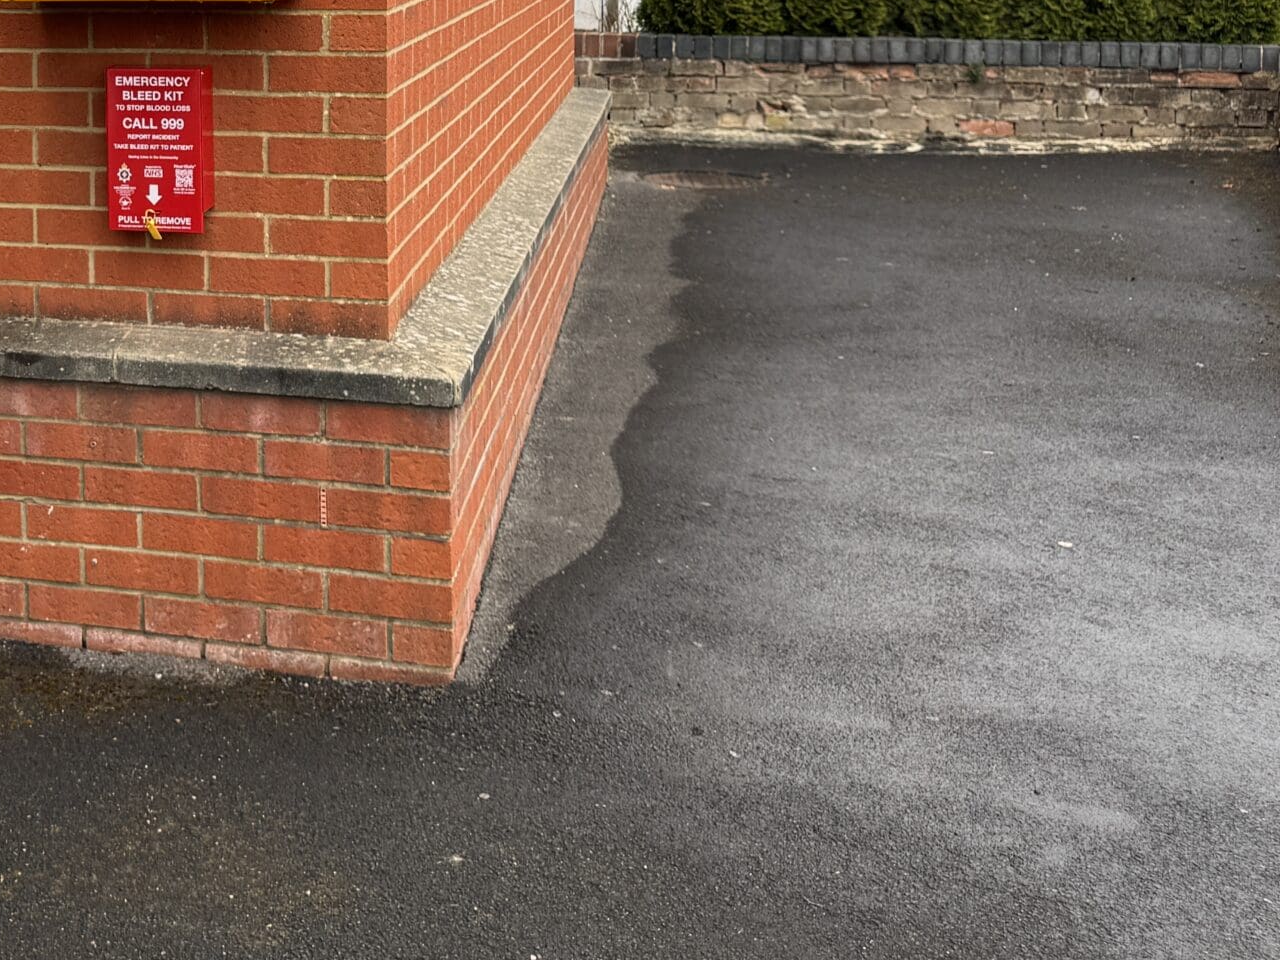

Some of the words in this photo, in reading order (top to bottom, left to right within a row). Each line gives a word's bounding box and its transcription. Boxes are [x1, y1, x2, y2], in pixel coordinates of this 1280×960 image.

[115, 76, 190, 87] EMERGENCY
[122, 91, 161, 101] BLEED
[164, 91, 184, 101] KIT
[122, 117, 158, 129] CALL
[161, 118, 184, 130] 999
[118, 215, 140, 224] PULL
[155, 216, 192, 225] REMOVE
